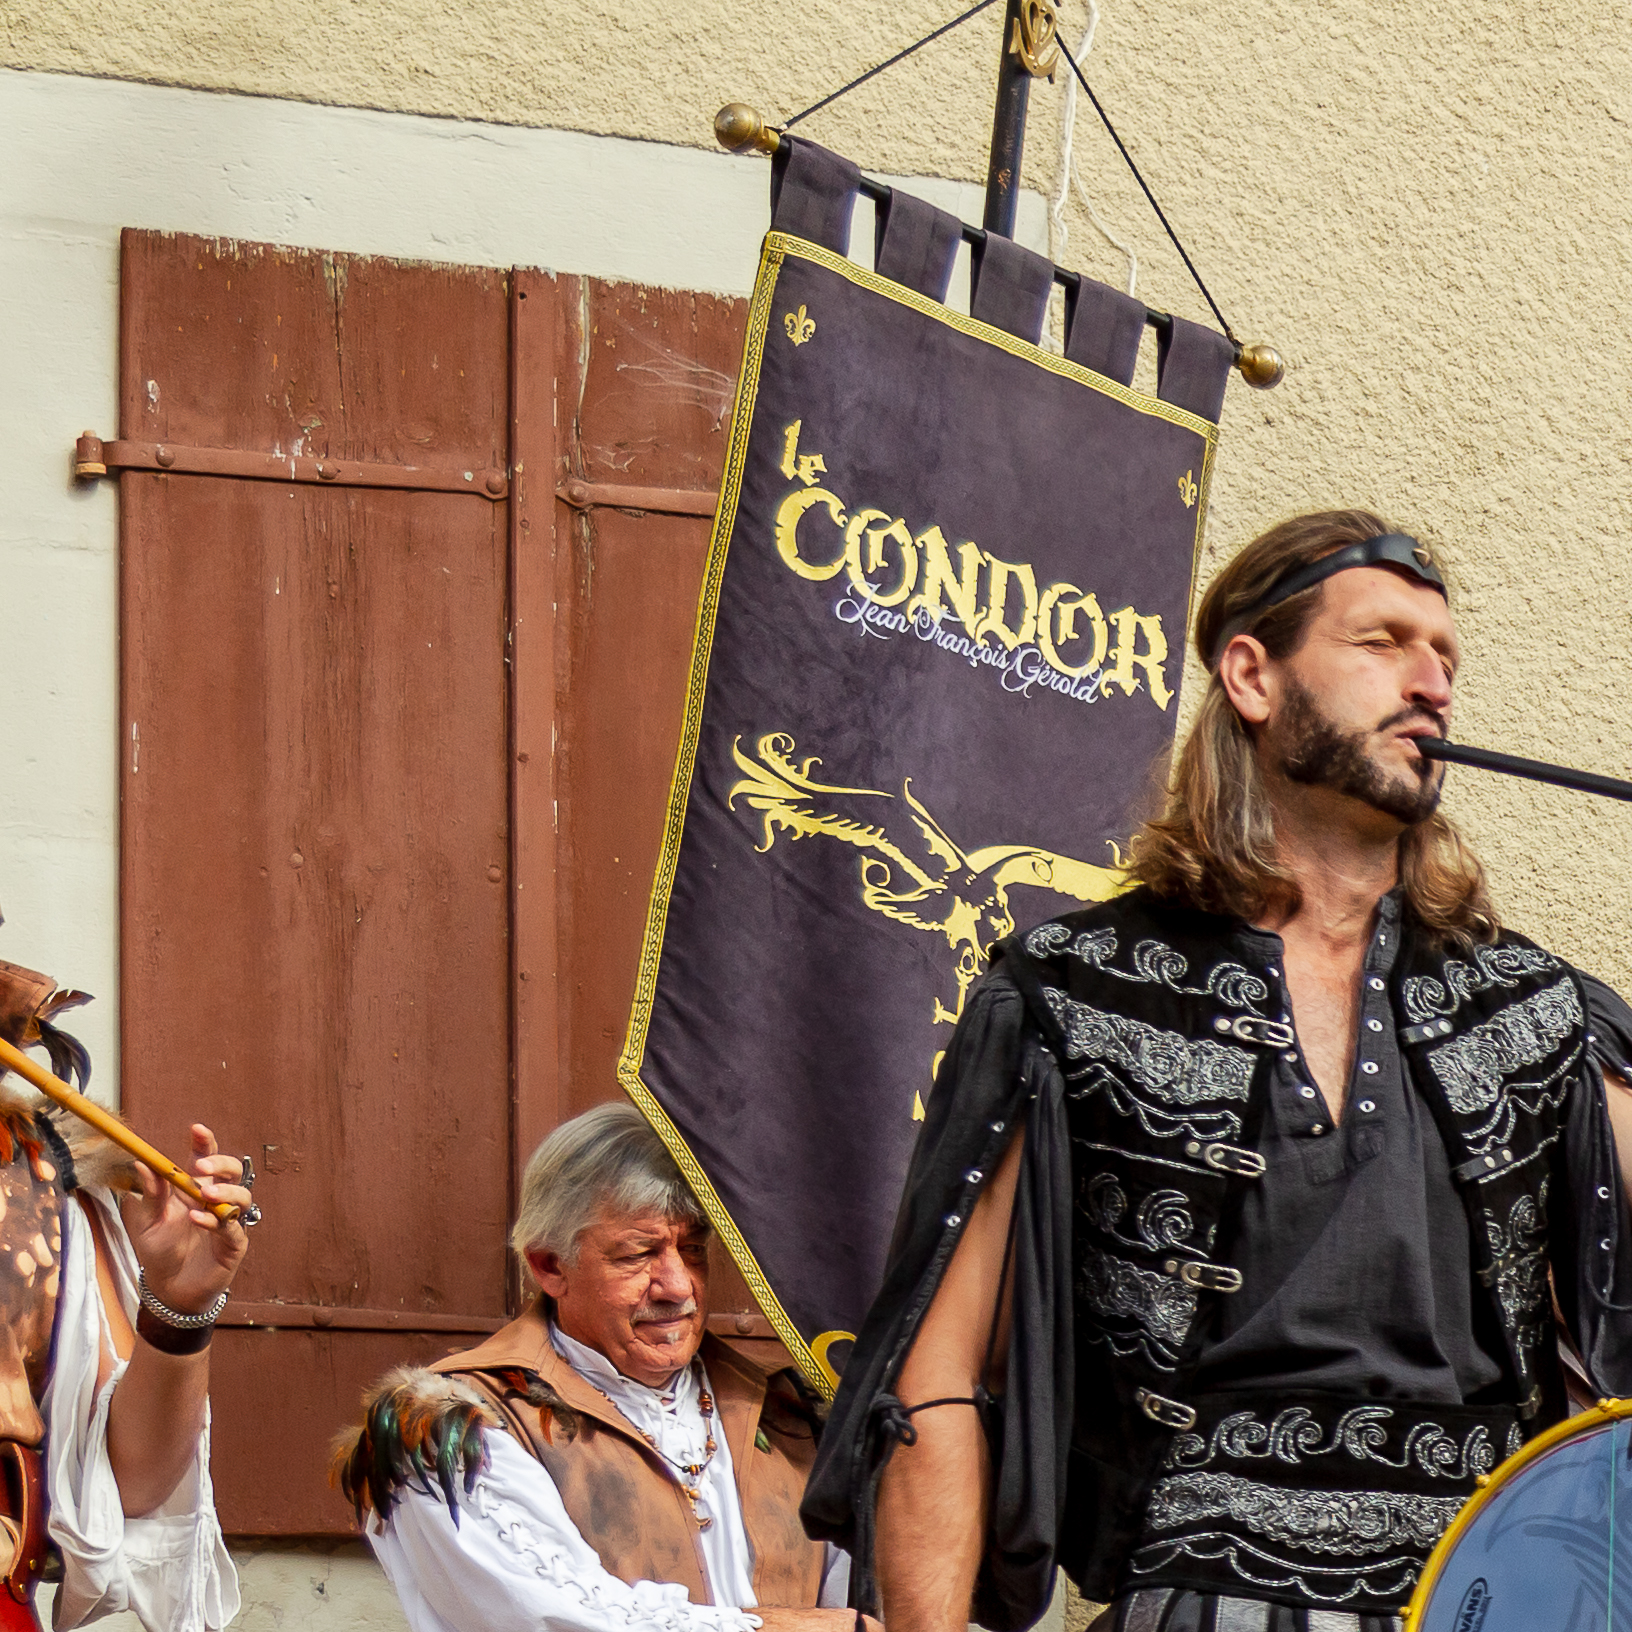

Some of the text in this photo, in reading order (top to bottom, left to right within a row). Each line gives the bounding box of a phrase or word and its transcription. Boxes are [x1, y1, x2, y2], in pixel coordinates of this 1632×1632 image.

[779, 419, 828, 486] le
[774, 486, 1175, 712] CONDOR
[835, 579, 1143, 704] Jean François Gérold
